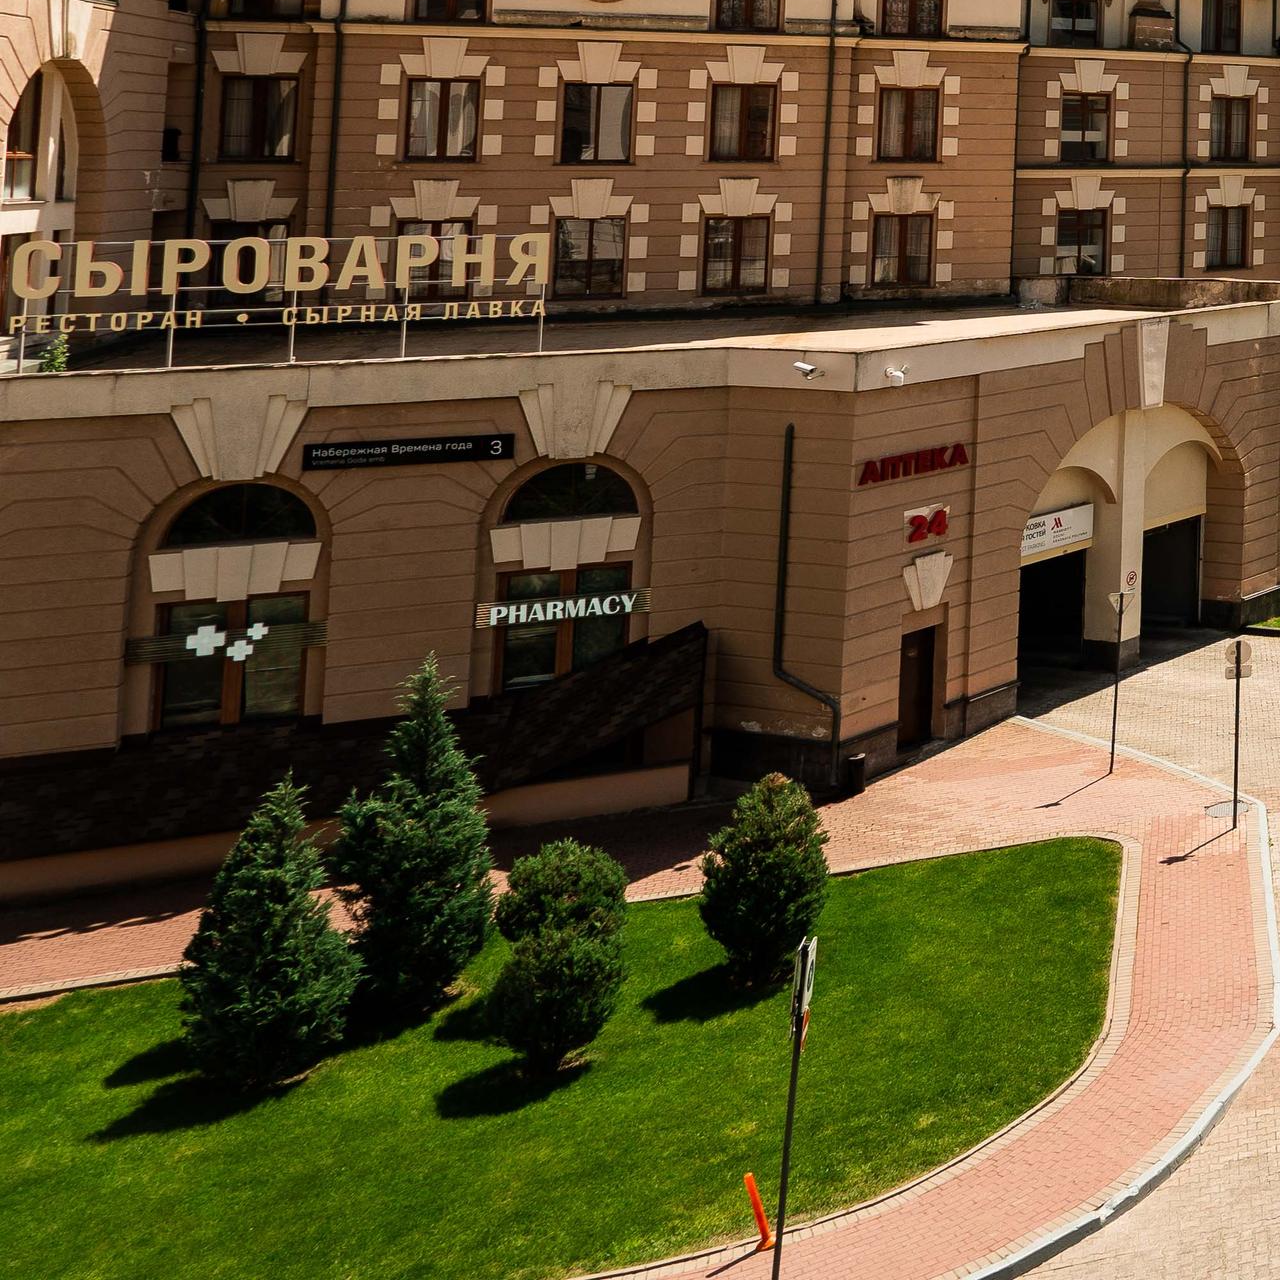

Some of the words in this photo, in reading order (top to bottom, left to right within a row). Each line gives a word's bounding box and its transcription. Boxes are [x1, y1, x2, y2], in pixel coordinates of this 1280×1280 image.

[12, 233, 551, 299] СЫРОВАРНЯ
[9, 310, 202, 335] РЕСТОРАН
[282, 303, 421, 326] СЫРНАЯ
[442, 299, 546, 321] ЛАВКА
[312, 446, 388, 458] Набережная
[391, 443, 442, 455] Времена
[445, 441, 473, 451] года
[490, 440, 502, 455] 3
[858, 442, 969, 486] АПТЕКА
[908, 509, 949, 544] 24
[1025, 520, 1047, 532] КОВКА
[1025, 529, 1047, 541] ГОСТЕЙ
[490, 593, 638, 626] PHARMACY
